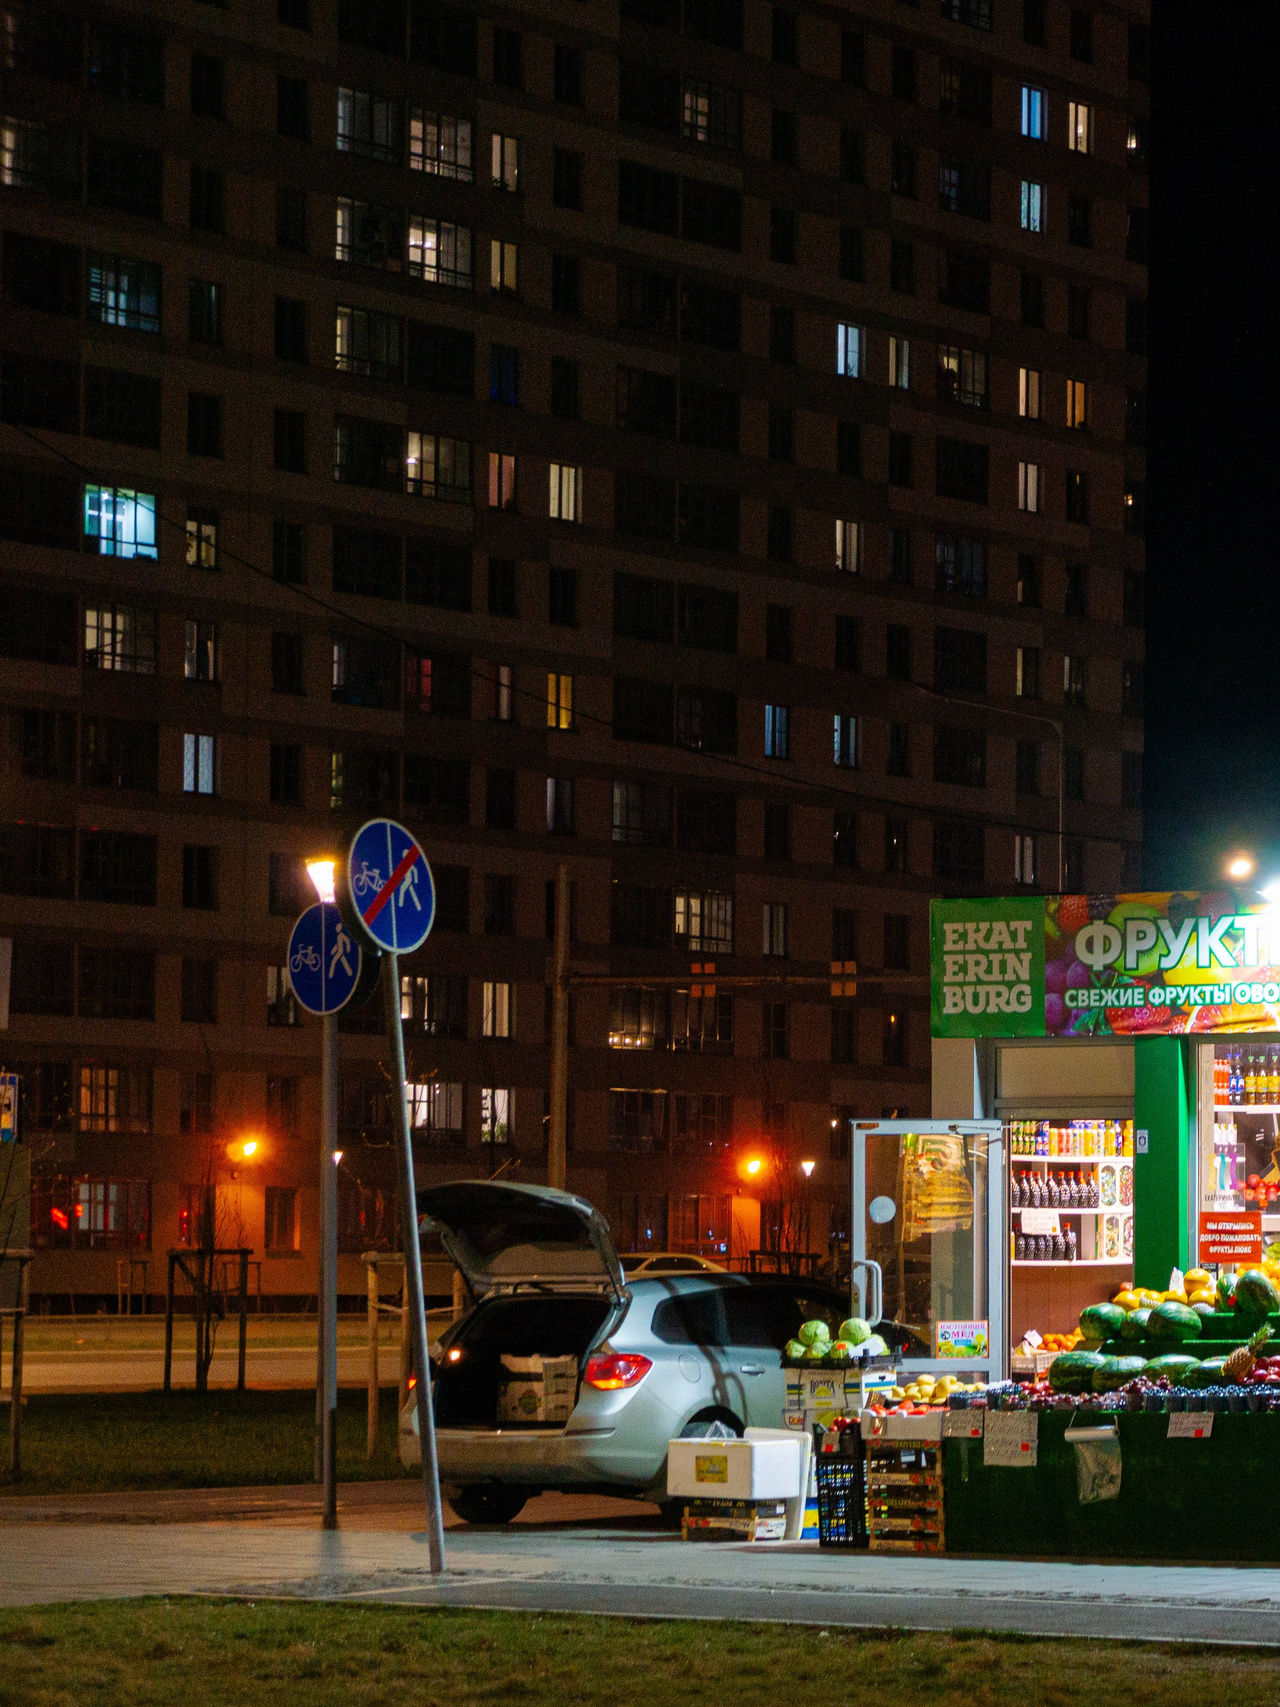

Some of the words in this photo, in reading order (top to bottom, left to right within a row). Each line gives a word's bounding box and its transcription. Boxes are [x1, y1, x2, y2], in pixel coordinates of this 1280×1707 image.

[943, 920, 1032, 950] EKAT
[943, 952, 1031, 983] ERIN
[943, 984, 1032, 1014] BURG
[1065, 987, 1144, 1007] СВЕЖИЕ
[1148, 984, 1231, 1007] ФРУКТЫ
[1200, 1234, 1220, 1242] ДОБРО
